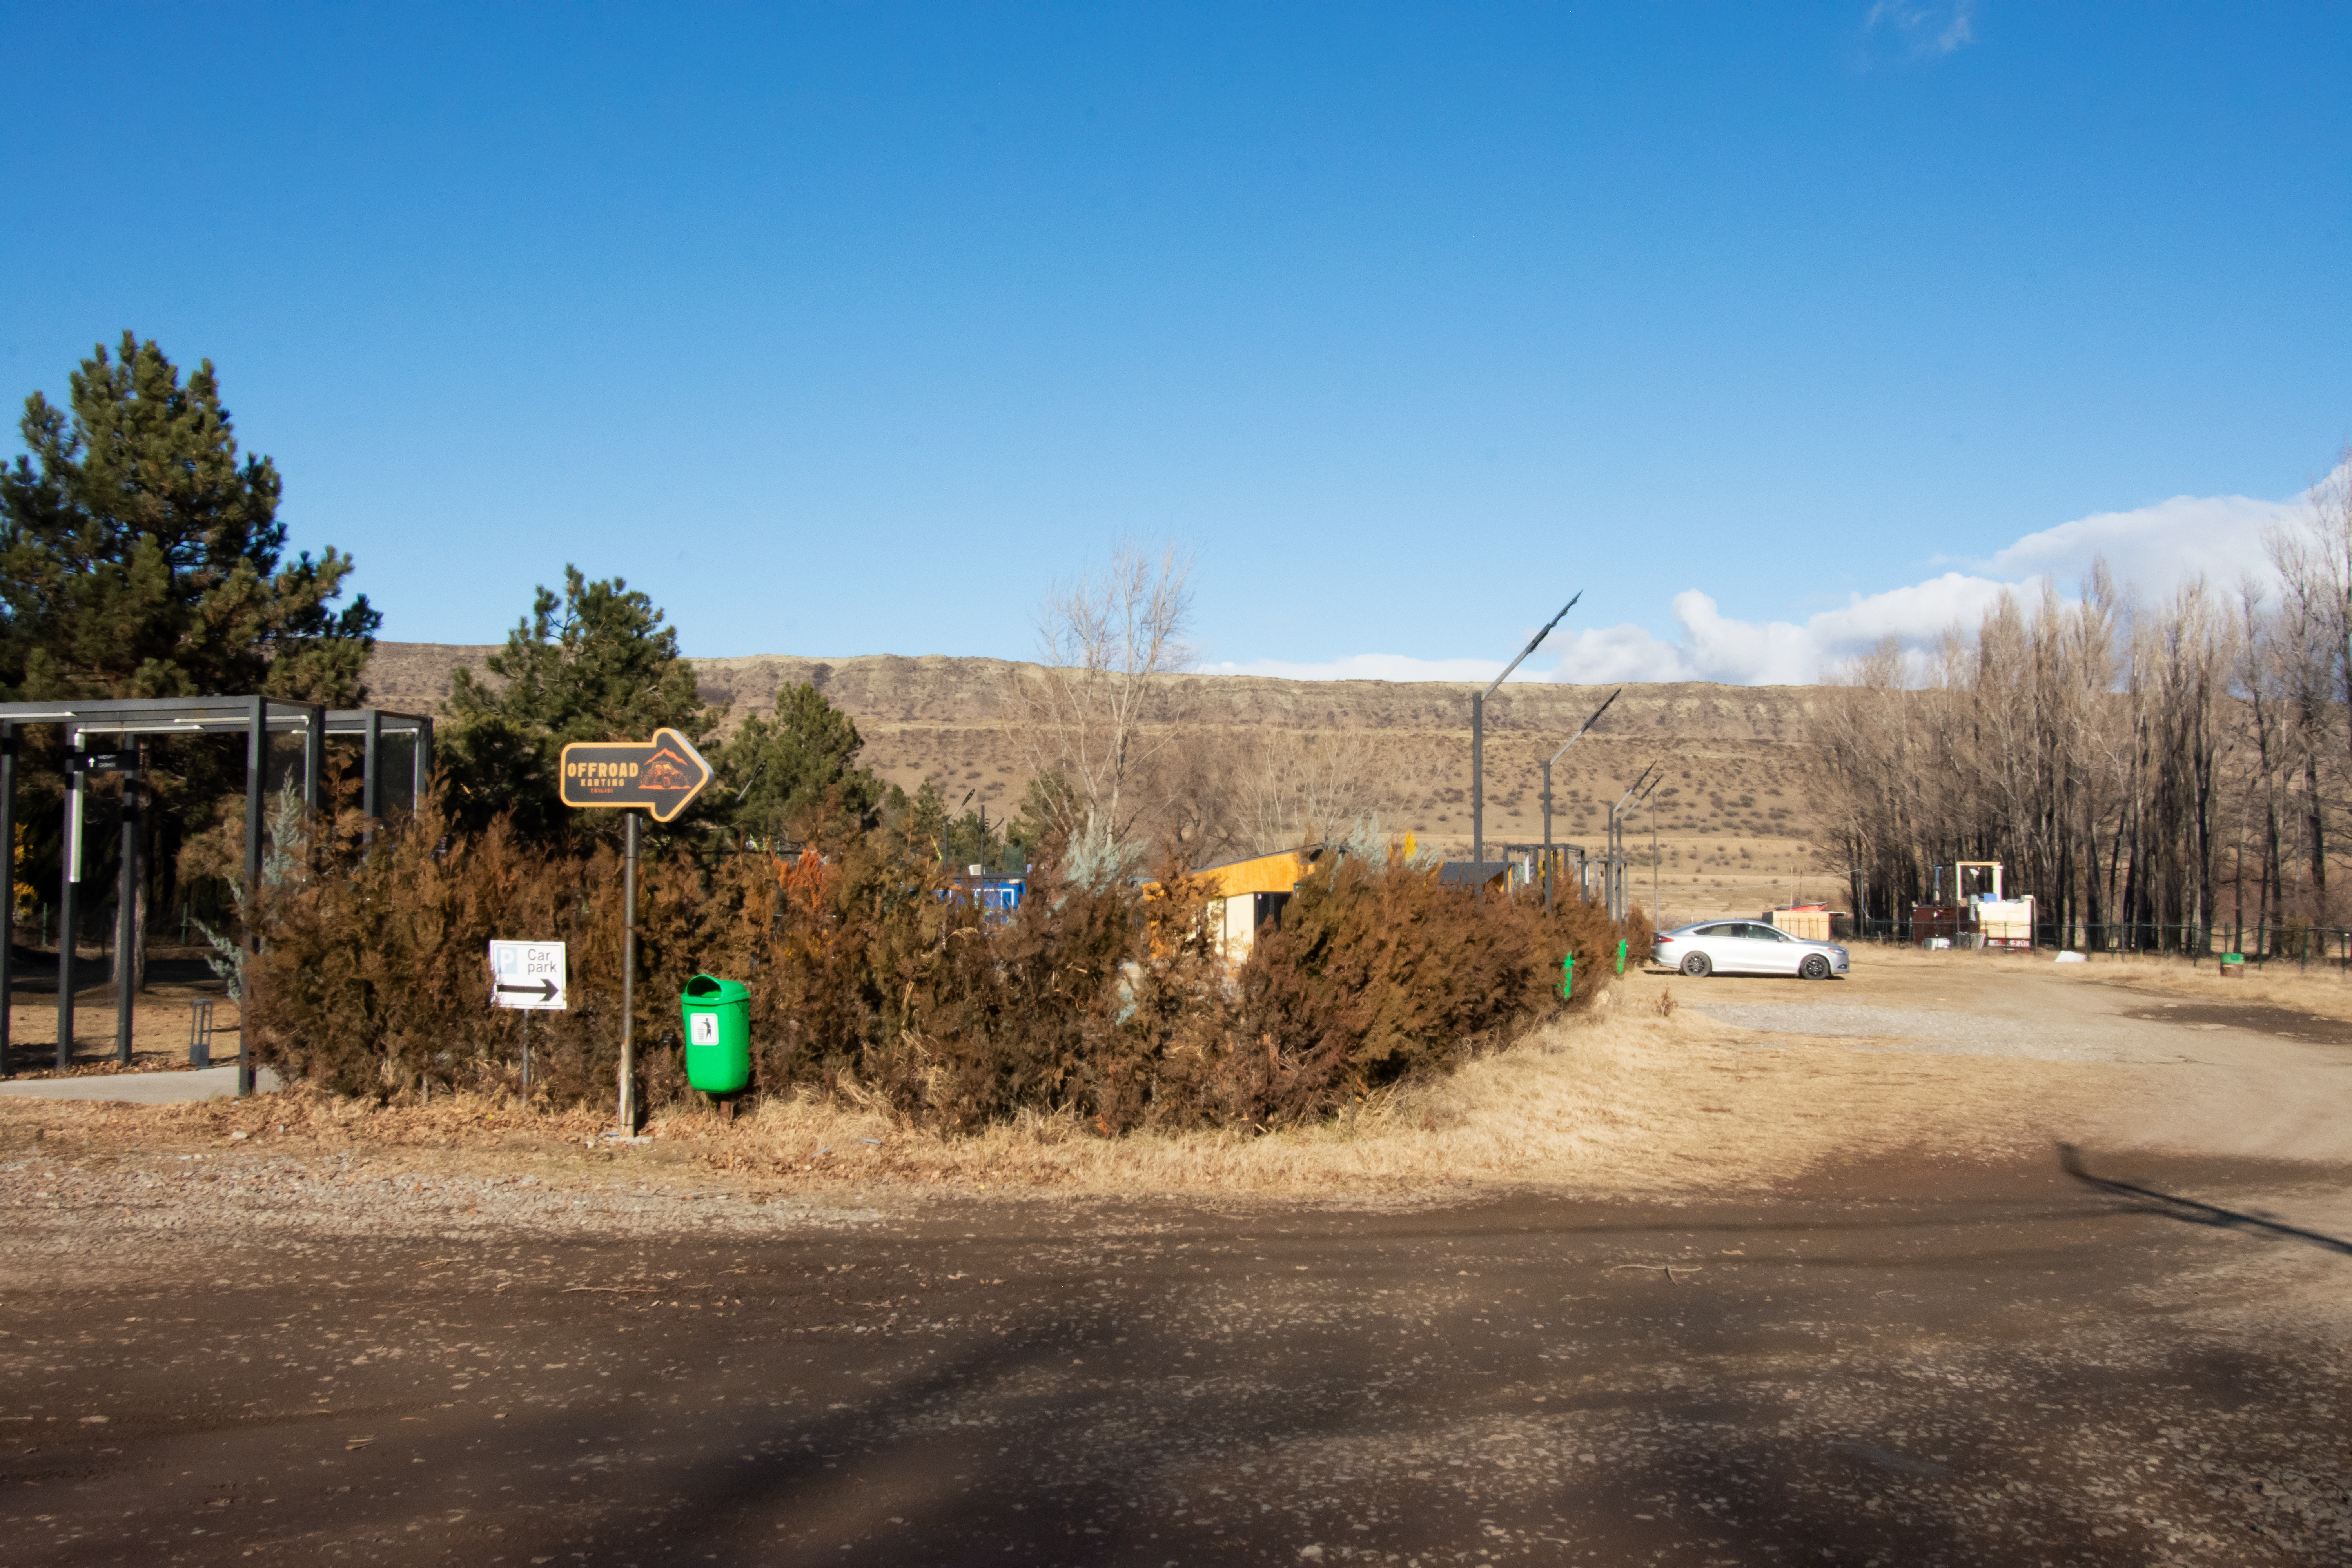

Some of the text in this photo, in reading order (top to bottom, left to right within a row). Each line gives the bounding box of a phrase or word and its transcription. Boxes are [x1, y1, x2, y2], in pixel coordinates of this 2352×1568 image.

[567, 762, 639, 777] OFFROAD
[580, 779, 625, 787] KARTING
[500, 949, 515, 971] P
[528, 948, 551, 961] Car
[528, 961, 557, 975] park
